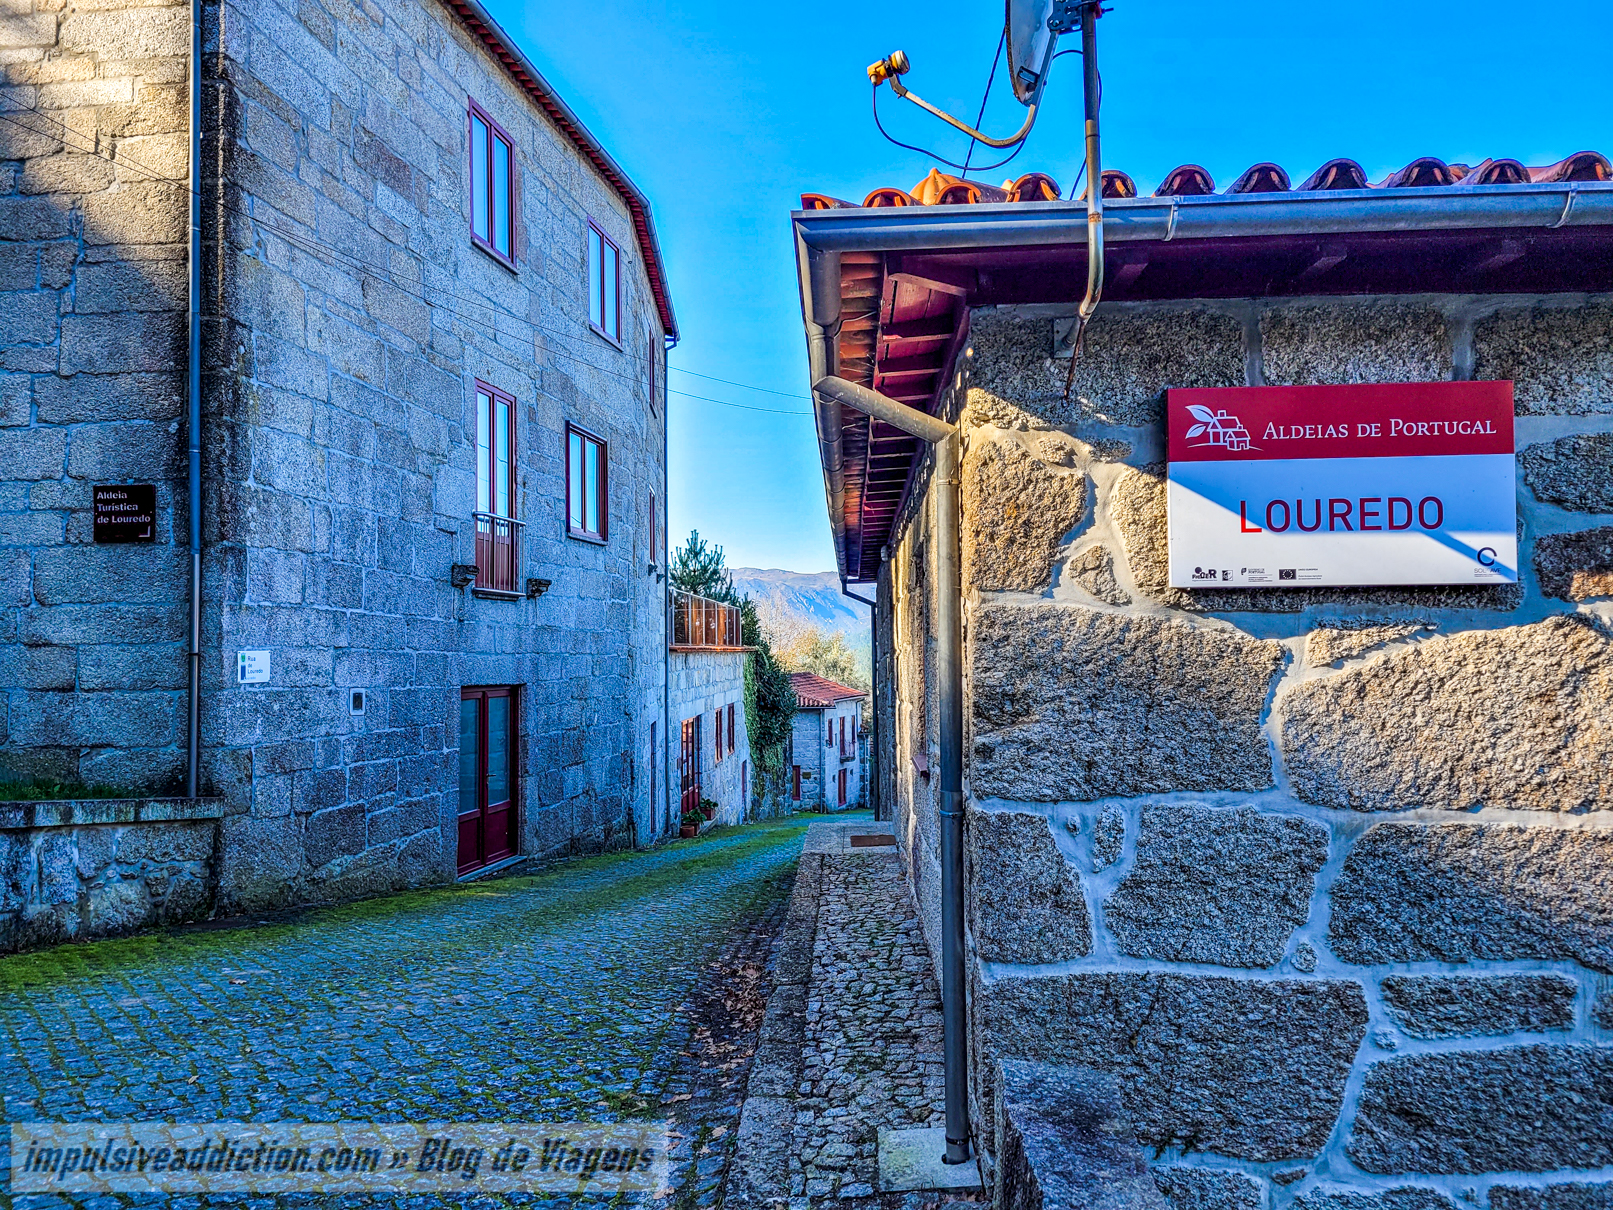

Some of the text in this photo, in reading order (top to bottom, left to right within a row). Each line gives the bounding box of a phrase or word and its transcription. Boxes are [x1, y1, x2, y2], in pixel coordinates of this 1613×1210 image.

[1389, 418, 1498, 437] PORTUGAL
[97, 491, 127, 499] Aldeia
[97, 503, 138, 511] Turística
[97, 514, 151, 524] de Louredo
[1240, 496, 1444, 533] LOUREDO
